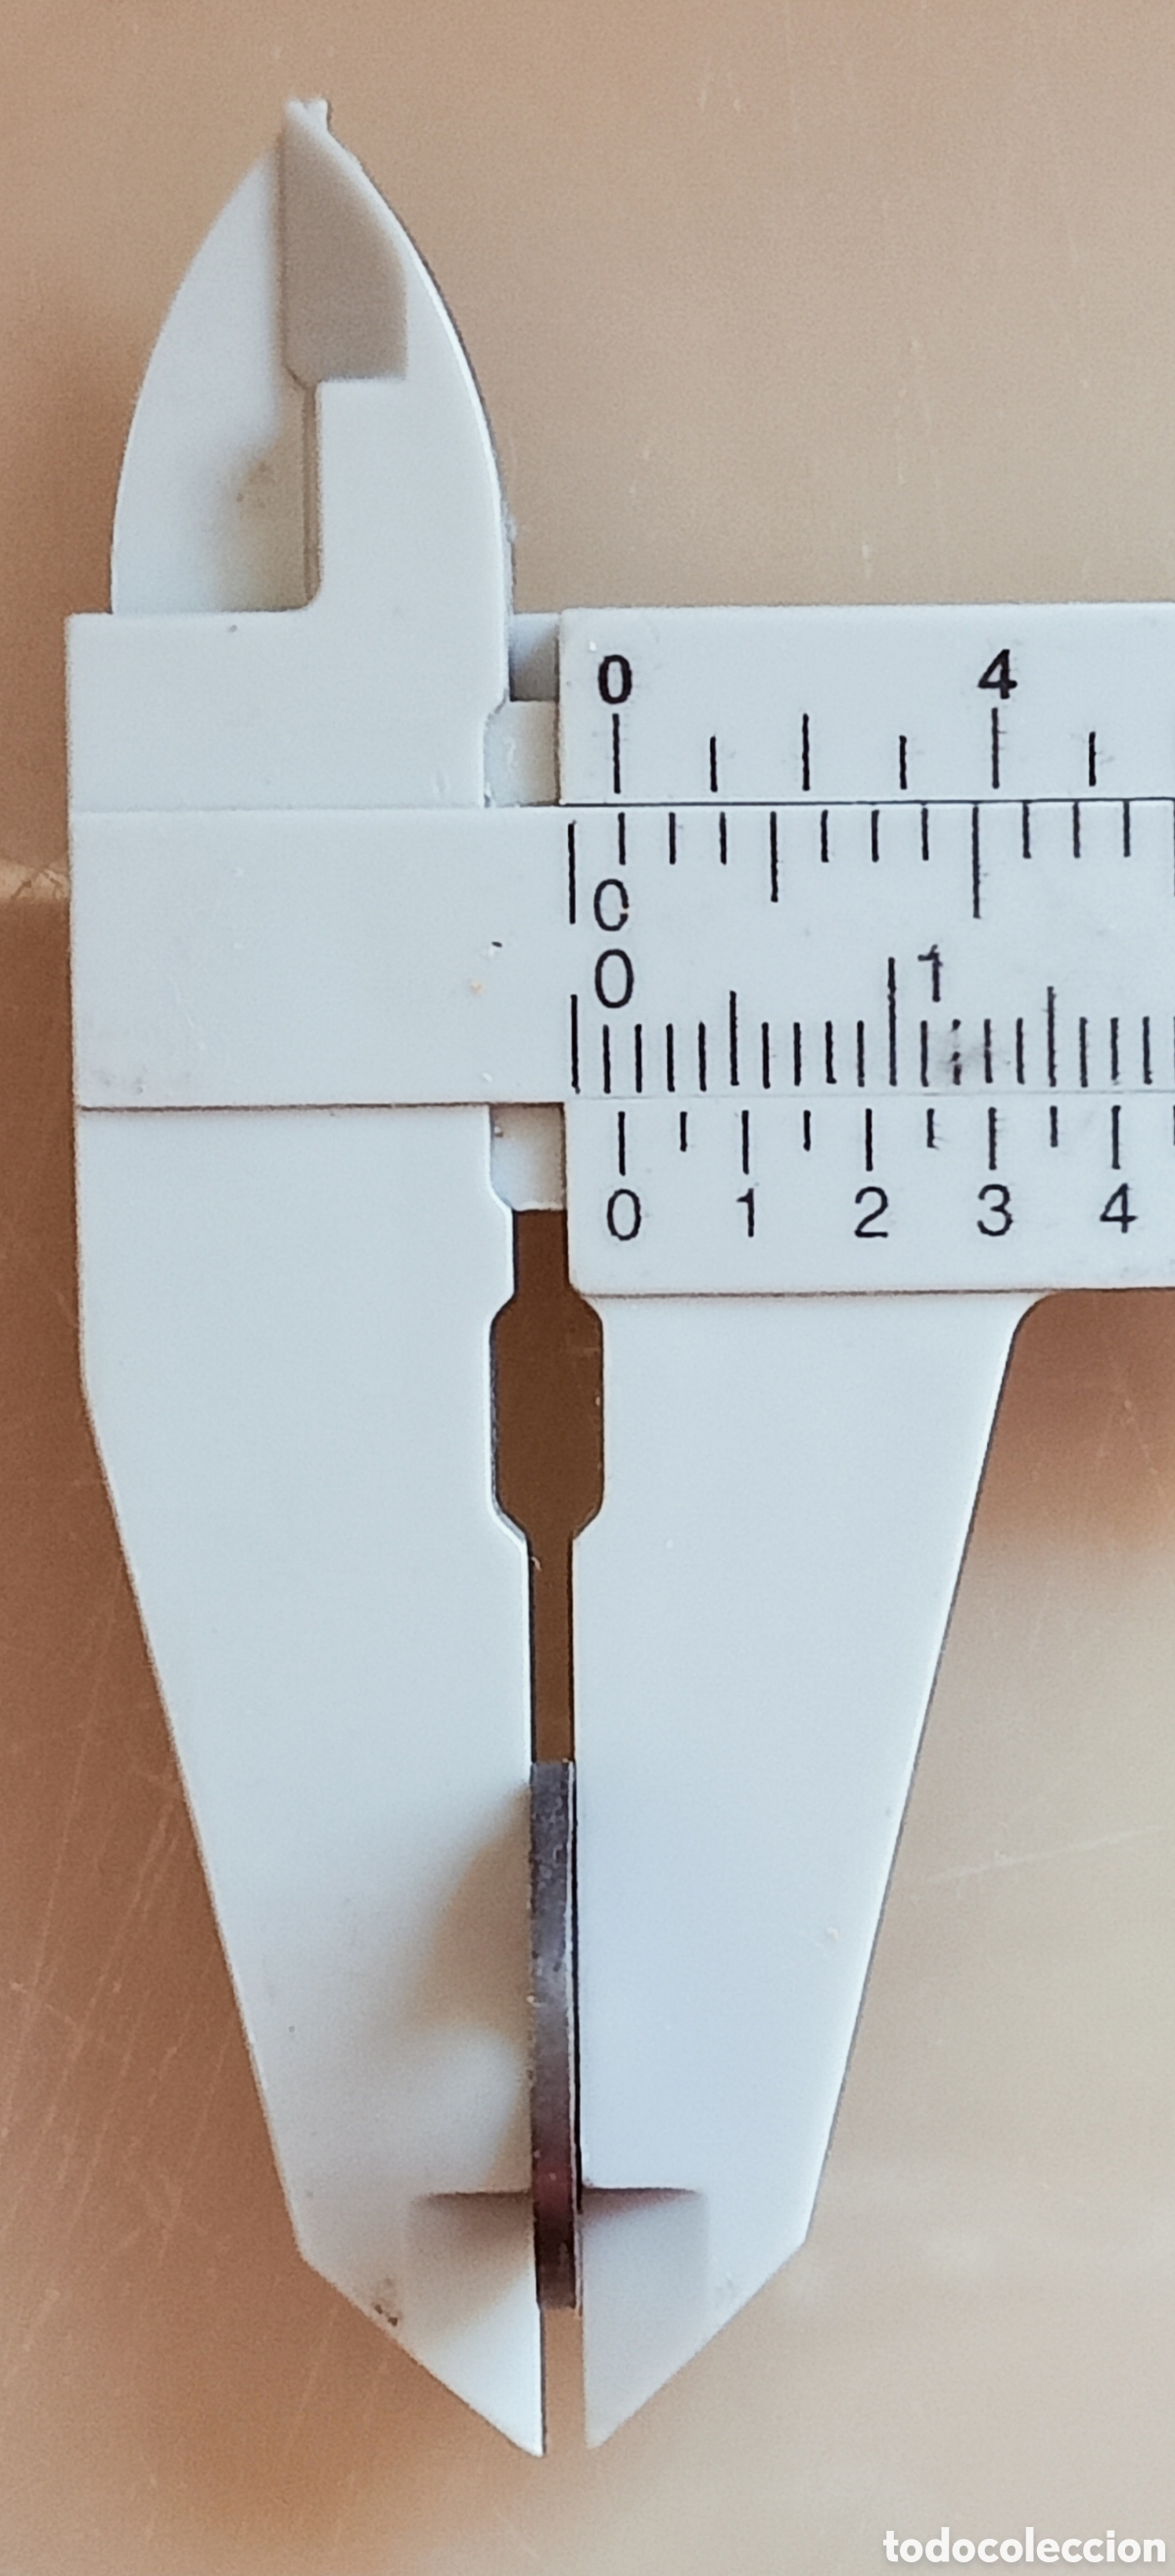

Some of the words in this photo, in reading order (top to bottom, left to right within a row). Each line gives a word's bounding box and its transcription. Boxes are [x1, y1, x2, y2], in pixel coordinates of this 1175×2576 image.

[597, 655, 633, 704] 0
[978, 649, 1017, 699] 4
[594, 949, 634, 1008] 0
[918, 945, 942, 1002] 1
[607, 1189, 641, 1241] 0
[737, 1189, 754, 1238] 1
[855, 1187, 888, 1238] 2
[977, 1184, 1013, 1237] 3
[1101, 1184, 1137, 1233] 4
